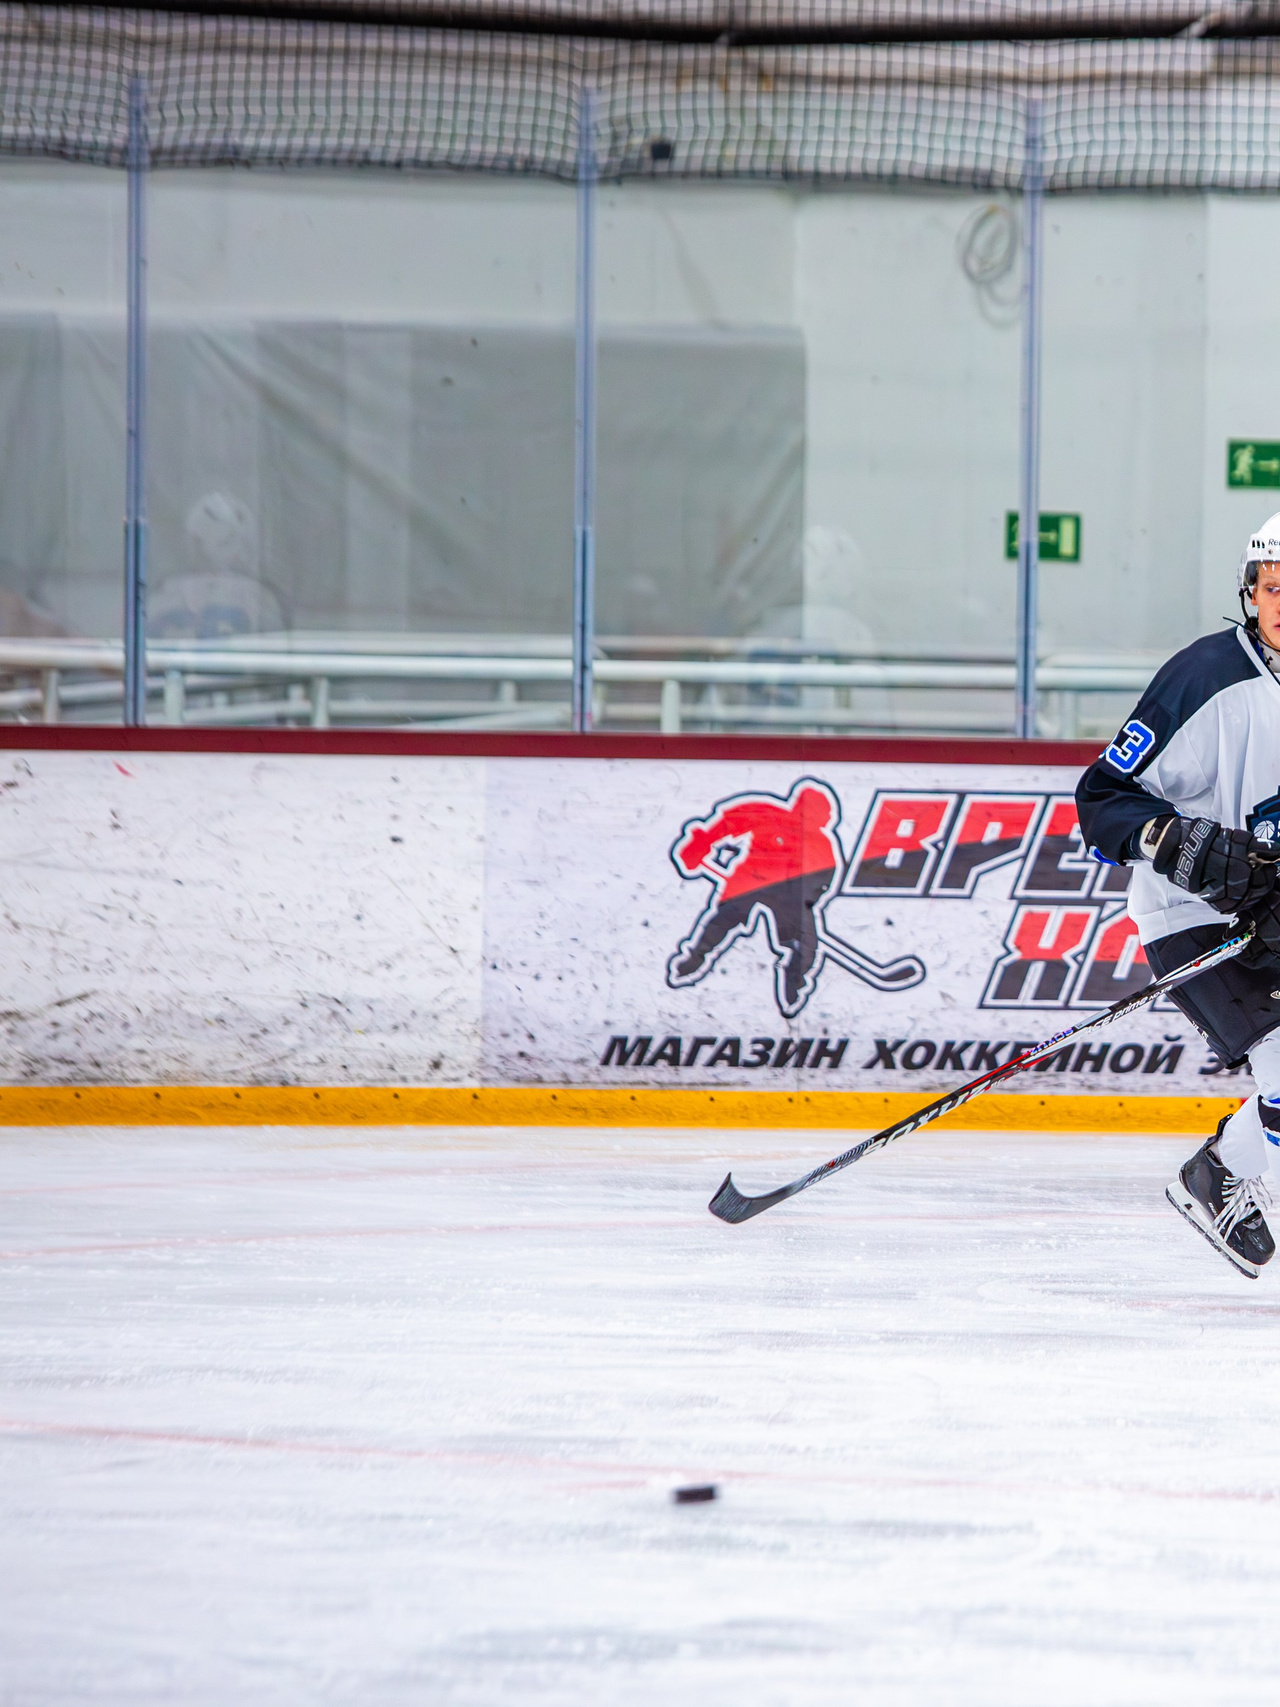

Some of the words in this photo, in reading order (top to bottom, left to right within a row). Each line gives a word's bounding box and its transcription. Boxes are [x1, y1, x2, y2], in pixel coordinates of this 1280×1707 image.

[1099, 719, 1156, 773] 3
[840, 788, 1132, 899] ВРЕ
[1173, 818, 1215, 892] BAUE
[601, 1035, 849, 1069] МАГАЗИН
